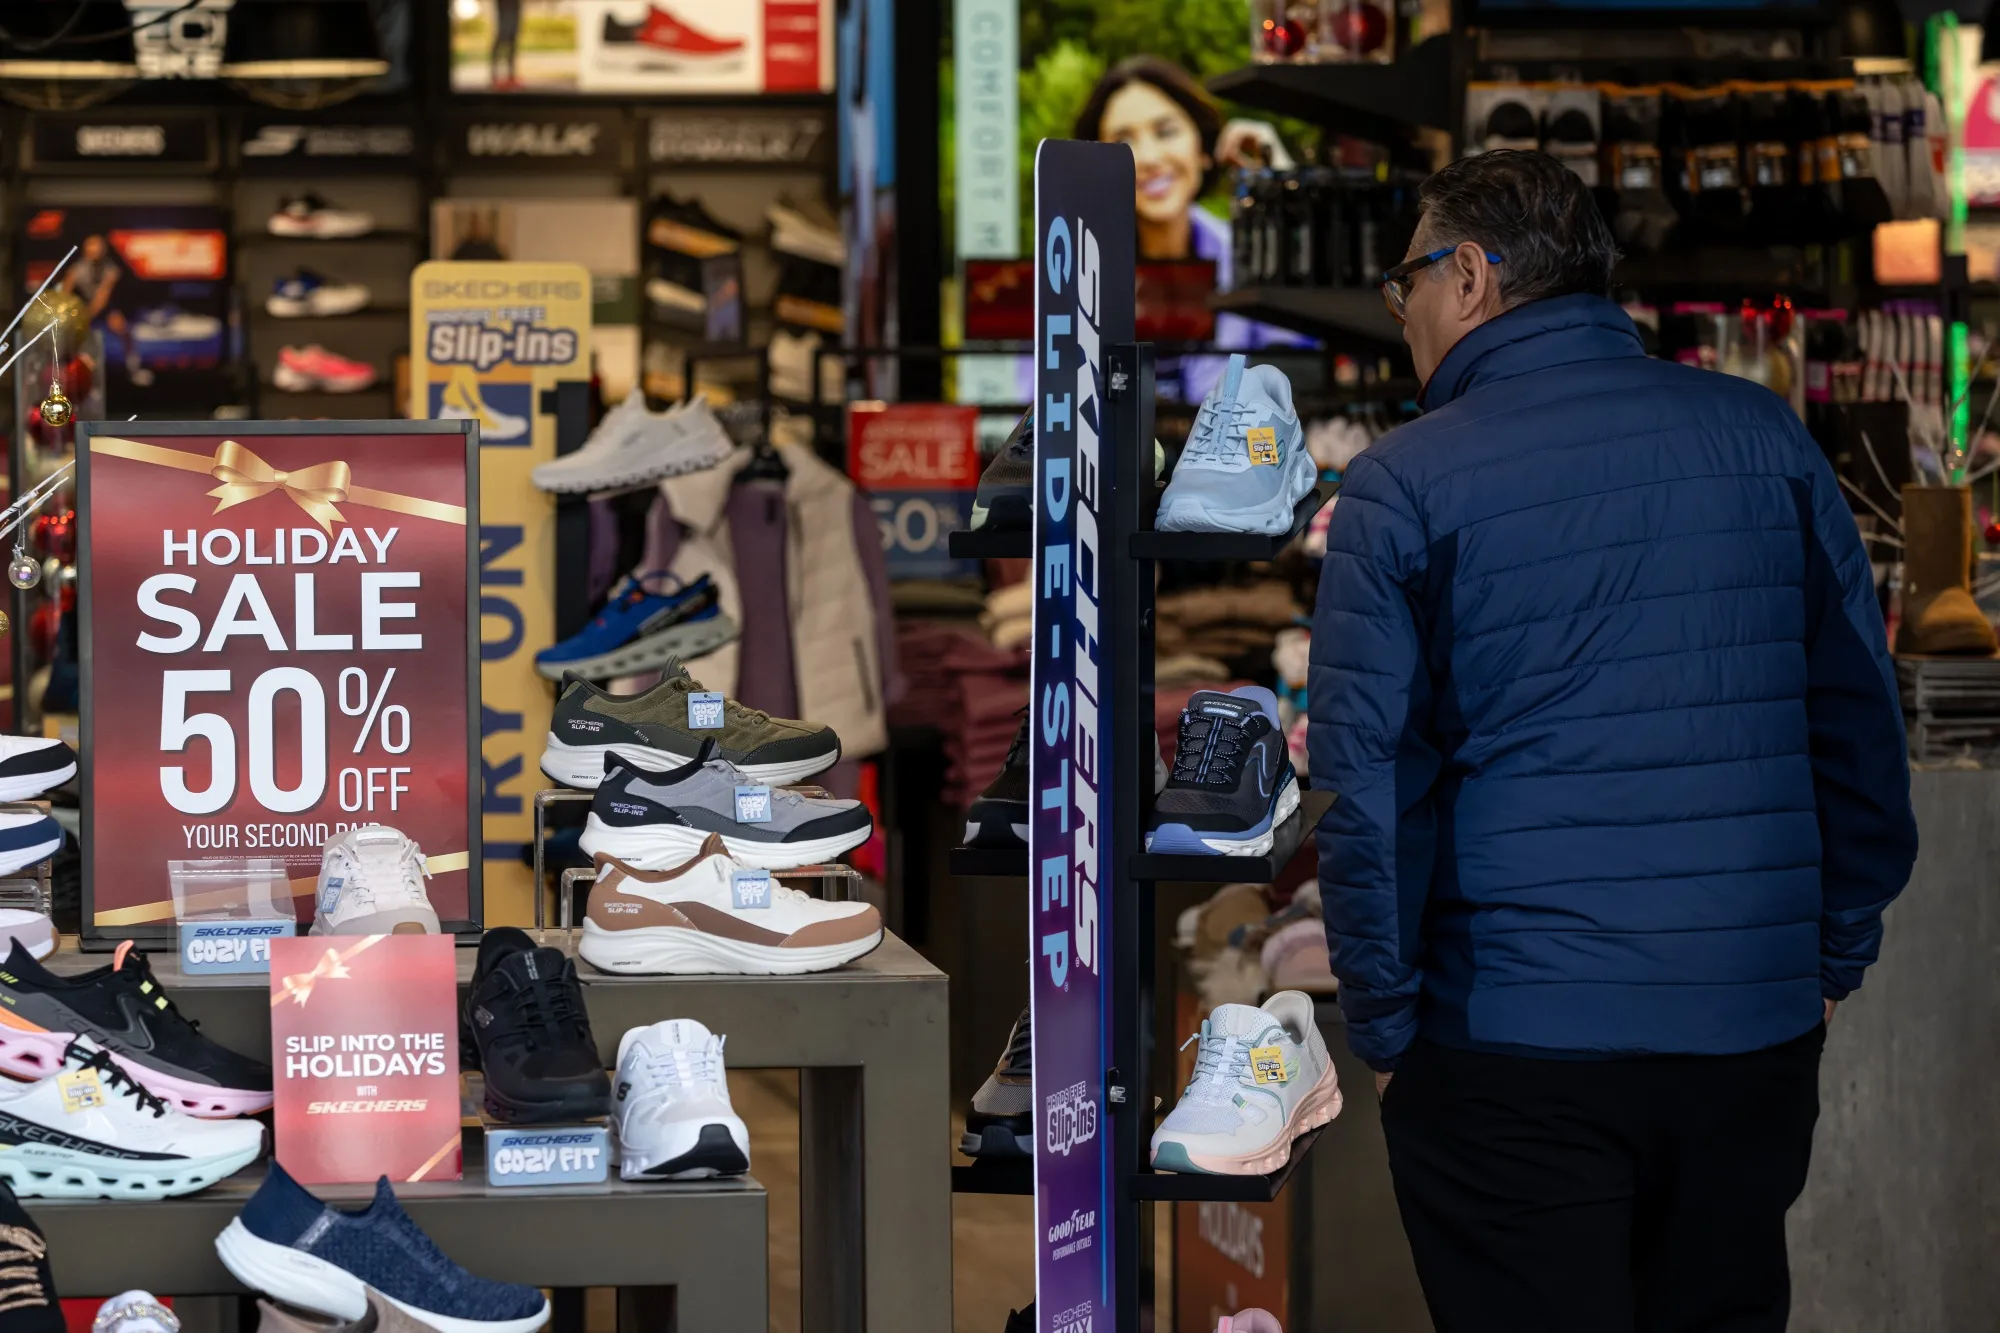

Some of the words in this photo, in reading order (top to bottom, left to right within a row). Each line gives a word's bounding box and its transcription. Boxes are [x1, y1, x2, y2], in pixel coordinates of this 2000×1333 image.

[423, 281, 583, 299] SKECHERS
[430, 322, 577, 371] Slip-ins
[859, 441, 968, 480] SALE
[163, 527, 399, 566] HOLIDAY
[1042, 215, 1072, 988] GLIDE-STEP
[1075, 216, 1100, 976] SKECHERS
[136, 571, 423, 654] SALE
[692, 703, 722, 715] COZY
[568, 718, 604, 727] SKECHERS
[571, 724, 600, 732] SLIP-INS
[695, 714, 718, 727] FIT
[338, 767, 412, 813] OFF
[610, 801, 648, 812] SKECHERS
[613, 807, 644, 816] SLIP-INS
[738, 796, 767, 809] COZY
[742, 807, 763, 820] FIT
[182, 823, 239, 849] YOUR
[245, 823, 329, 848] SECOND
[737, 881, 768, 894] COZY
[740, 893, 764, 906] FIT
[194, 926, 285, 937] SKECHERS
[187, 937, 248, 965] COZY
[250, 937, 270, 963] FI
[286, 1035, 335, 1053] SLIP
[341, 1033, 396, 1052] INTO
[400, 1032, 445, 1050] THE
[286, 1052, 446, 1079] HOLIDAYS
[1256, 1062, 1281, 1072] Slip-ins
[356, 1085, 378, 1097] WITH
[1070, 1081, 1086, 1102] FREE
[306, 1099, 428, 1115] SKECHERS
[1047, 1100, 1096, 1156] Slip-ins
[501, 1134, 595, 1147] SKECHERS
[494, 1147, 557, 1175] COZY
[560, 1147, 600, 1172] FIT
[1053, 1300, 1092, 1328] SKECHERS
